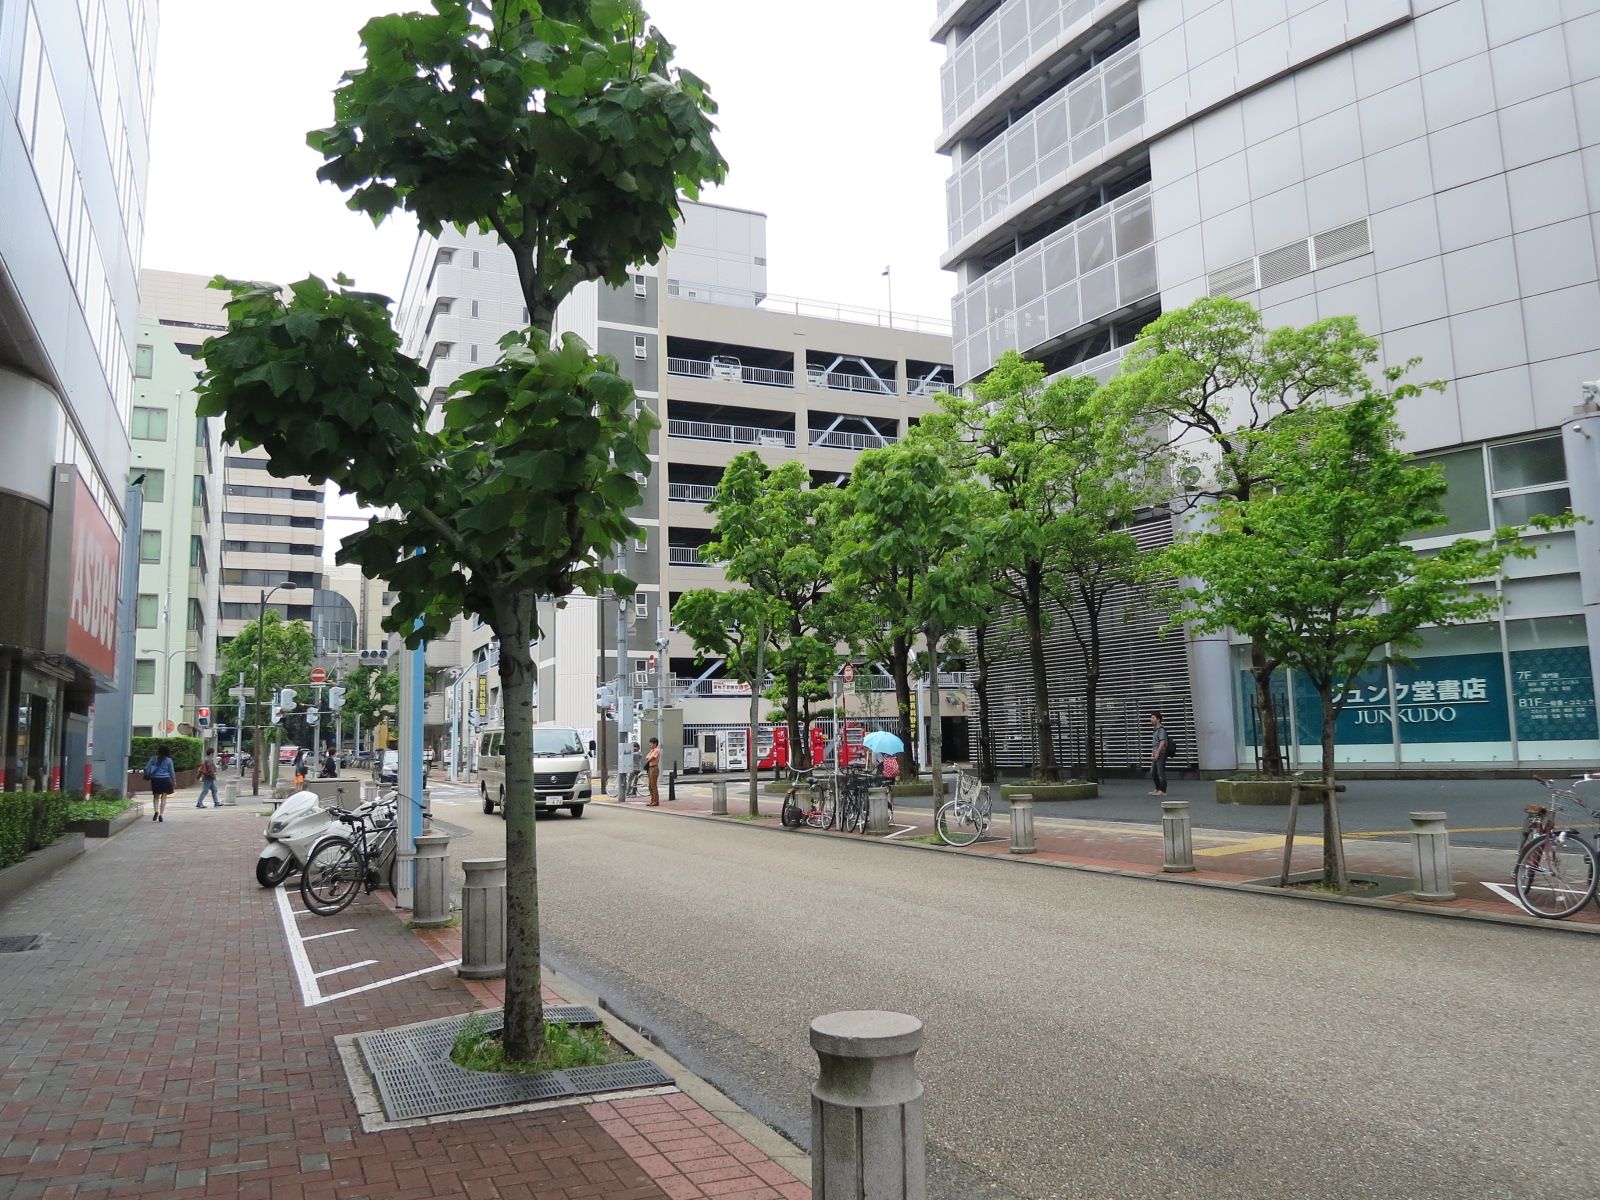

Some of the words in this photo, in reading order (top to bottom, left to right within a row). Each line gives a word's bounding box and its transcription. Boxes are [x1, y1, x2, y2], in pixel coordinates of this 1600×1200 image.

[1516, 671, 1532, 680] 7F
[1518, 697, 1542, 708] B1F
[1354, 706, 1457, 725] JUNKUDO
